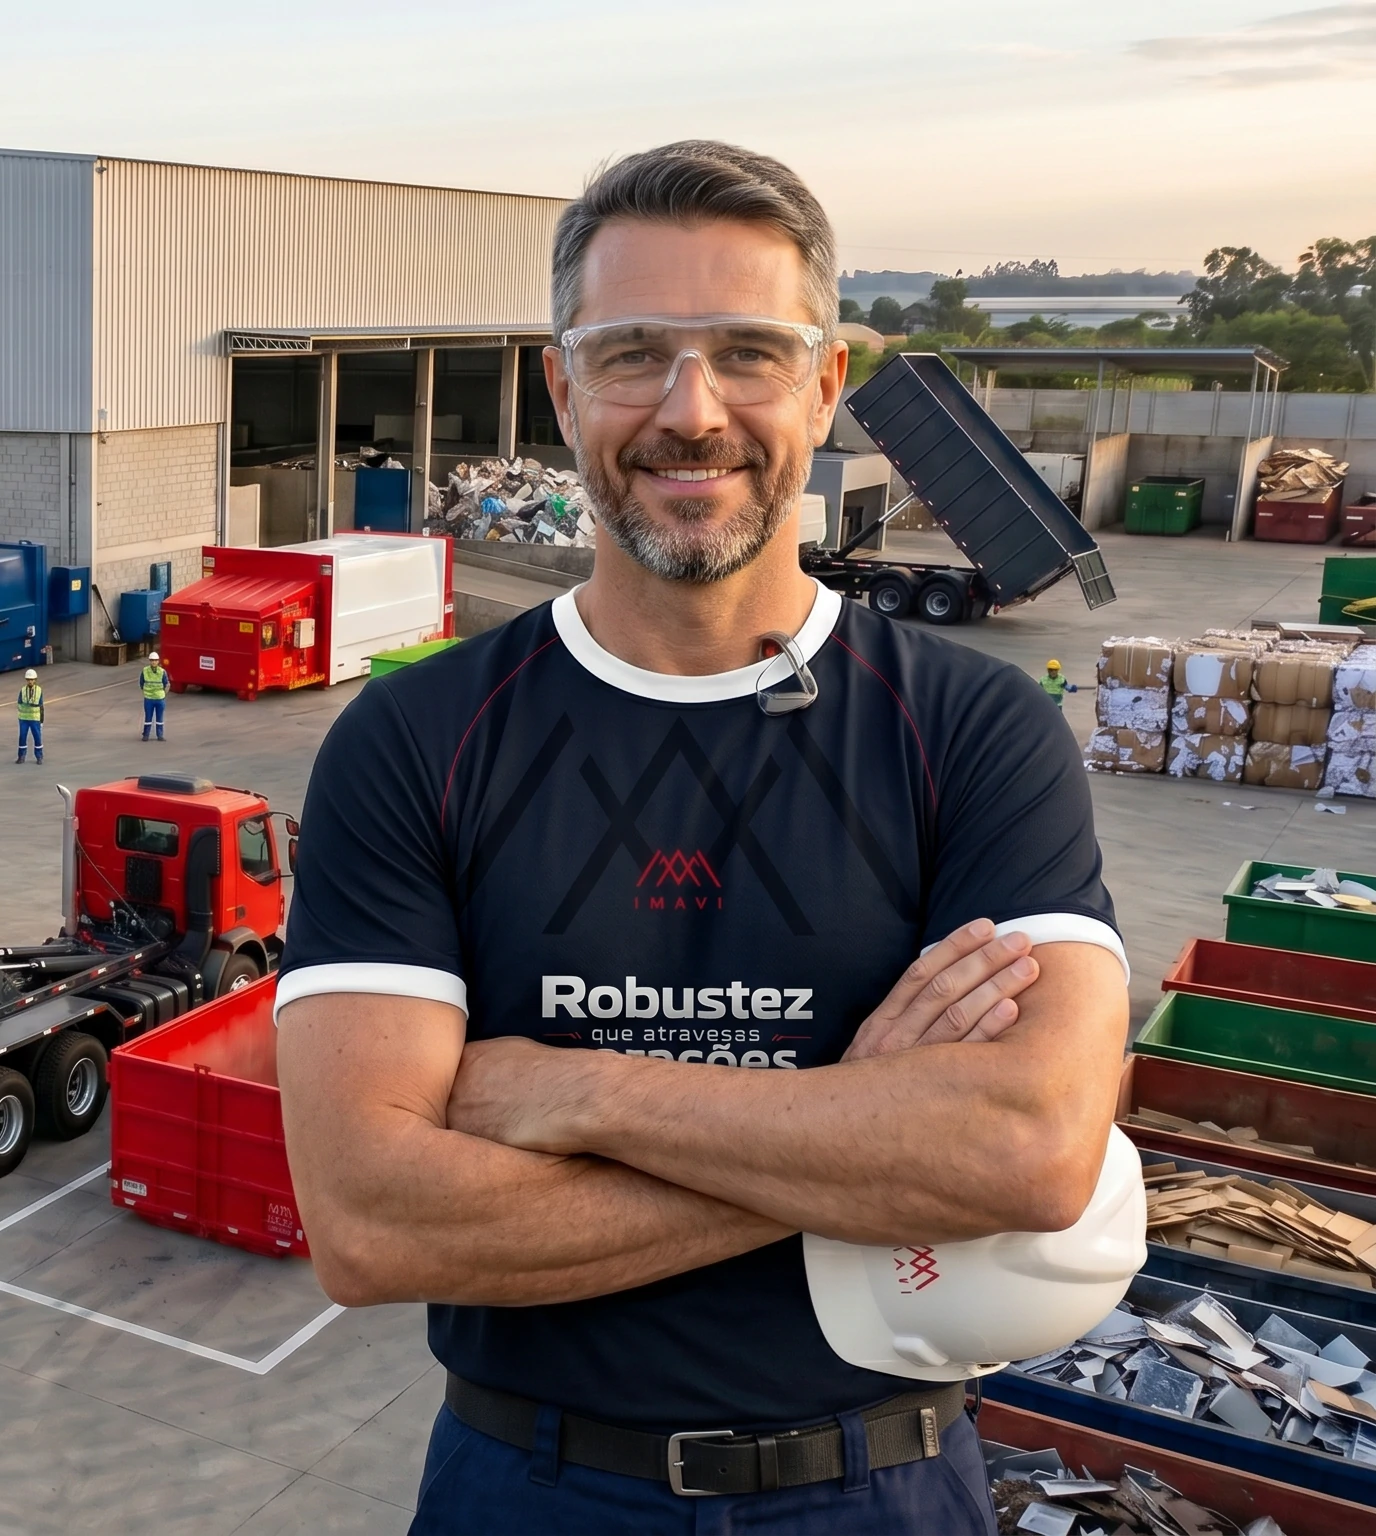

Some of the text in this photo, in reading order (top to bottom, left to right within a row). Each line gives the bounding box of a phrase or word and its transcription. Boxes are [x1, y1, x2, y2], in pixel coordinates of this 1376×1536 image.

[634, 896, 723, 910] IMAVI
[541, 975, 814, 1020] Robustez
[591, 1026, 761, 1045] que atravesas
